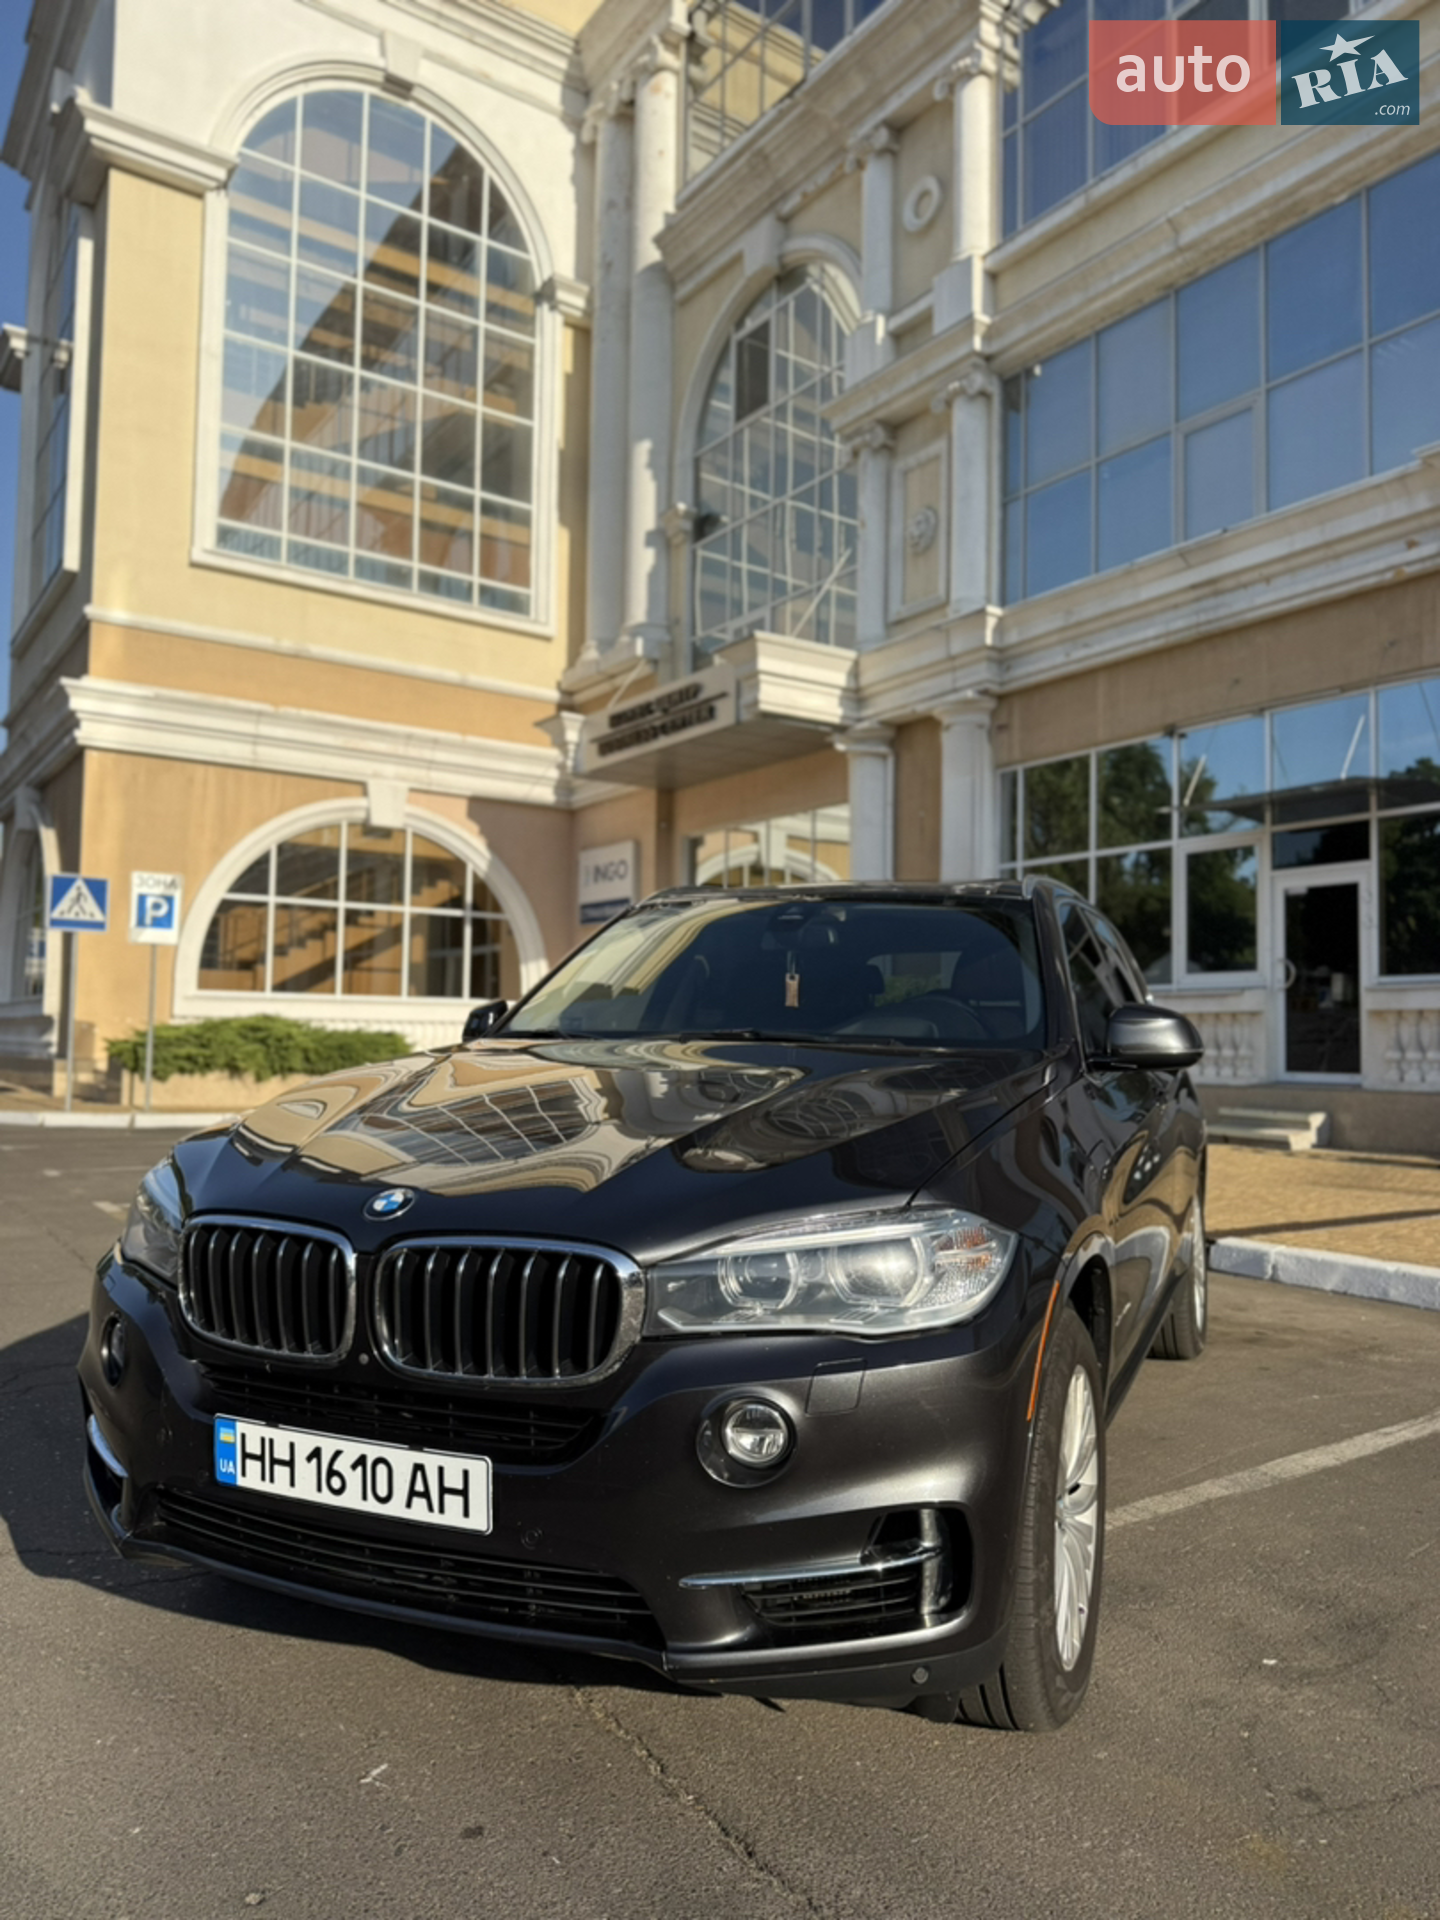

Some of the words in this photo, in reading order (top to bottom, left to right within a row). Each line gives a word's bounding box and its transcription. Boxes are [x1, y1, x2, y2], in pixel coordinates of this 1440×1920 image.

[136, 875, 179, 890] ЗОНА
[219, 1460, 236, 1474] UA
[305, 1446, 393, 1504] 1610
